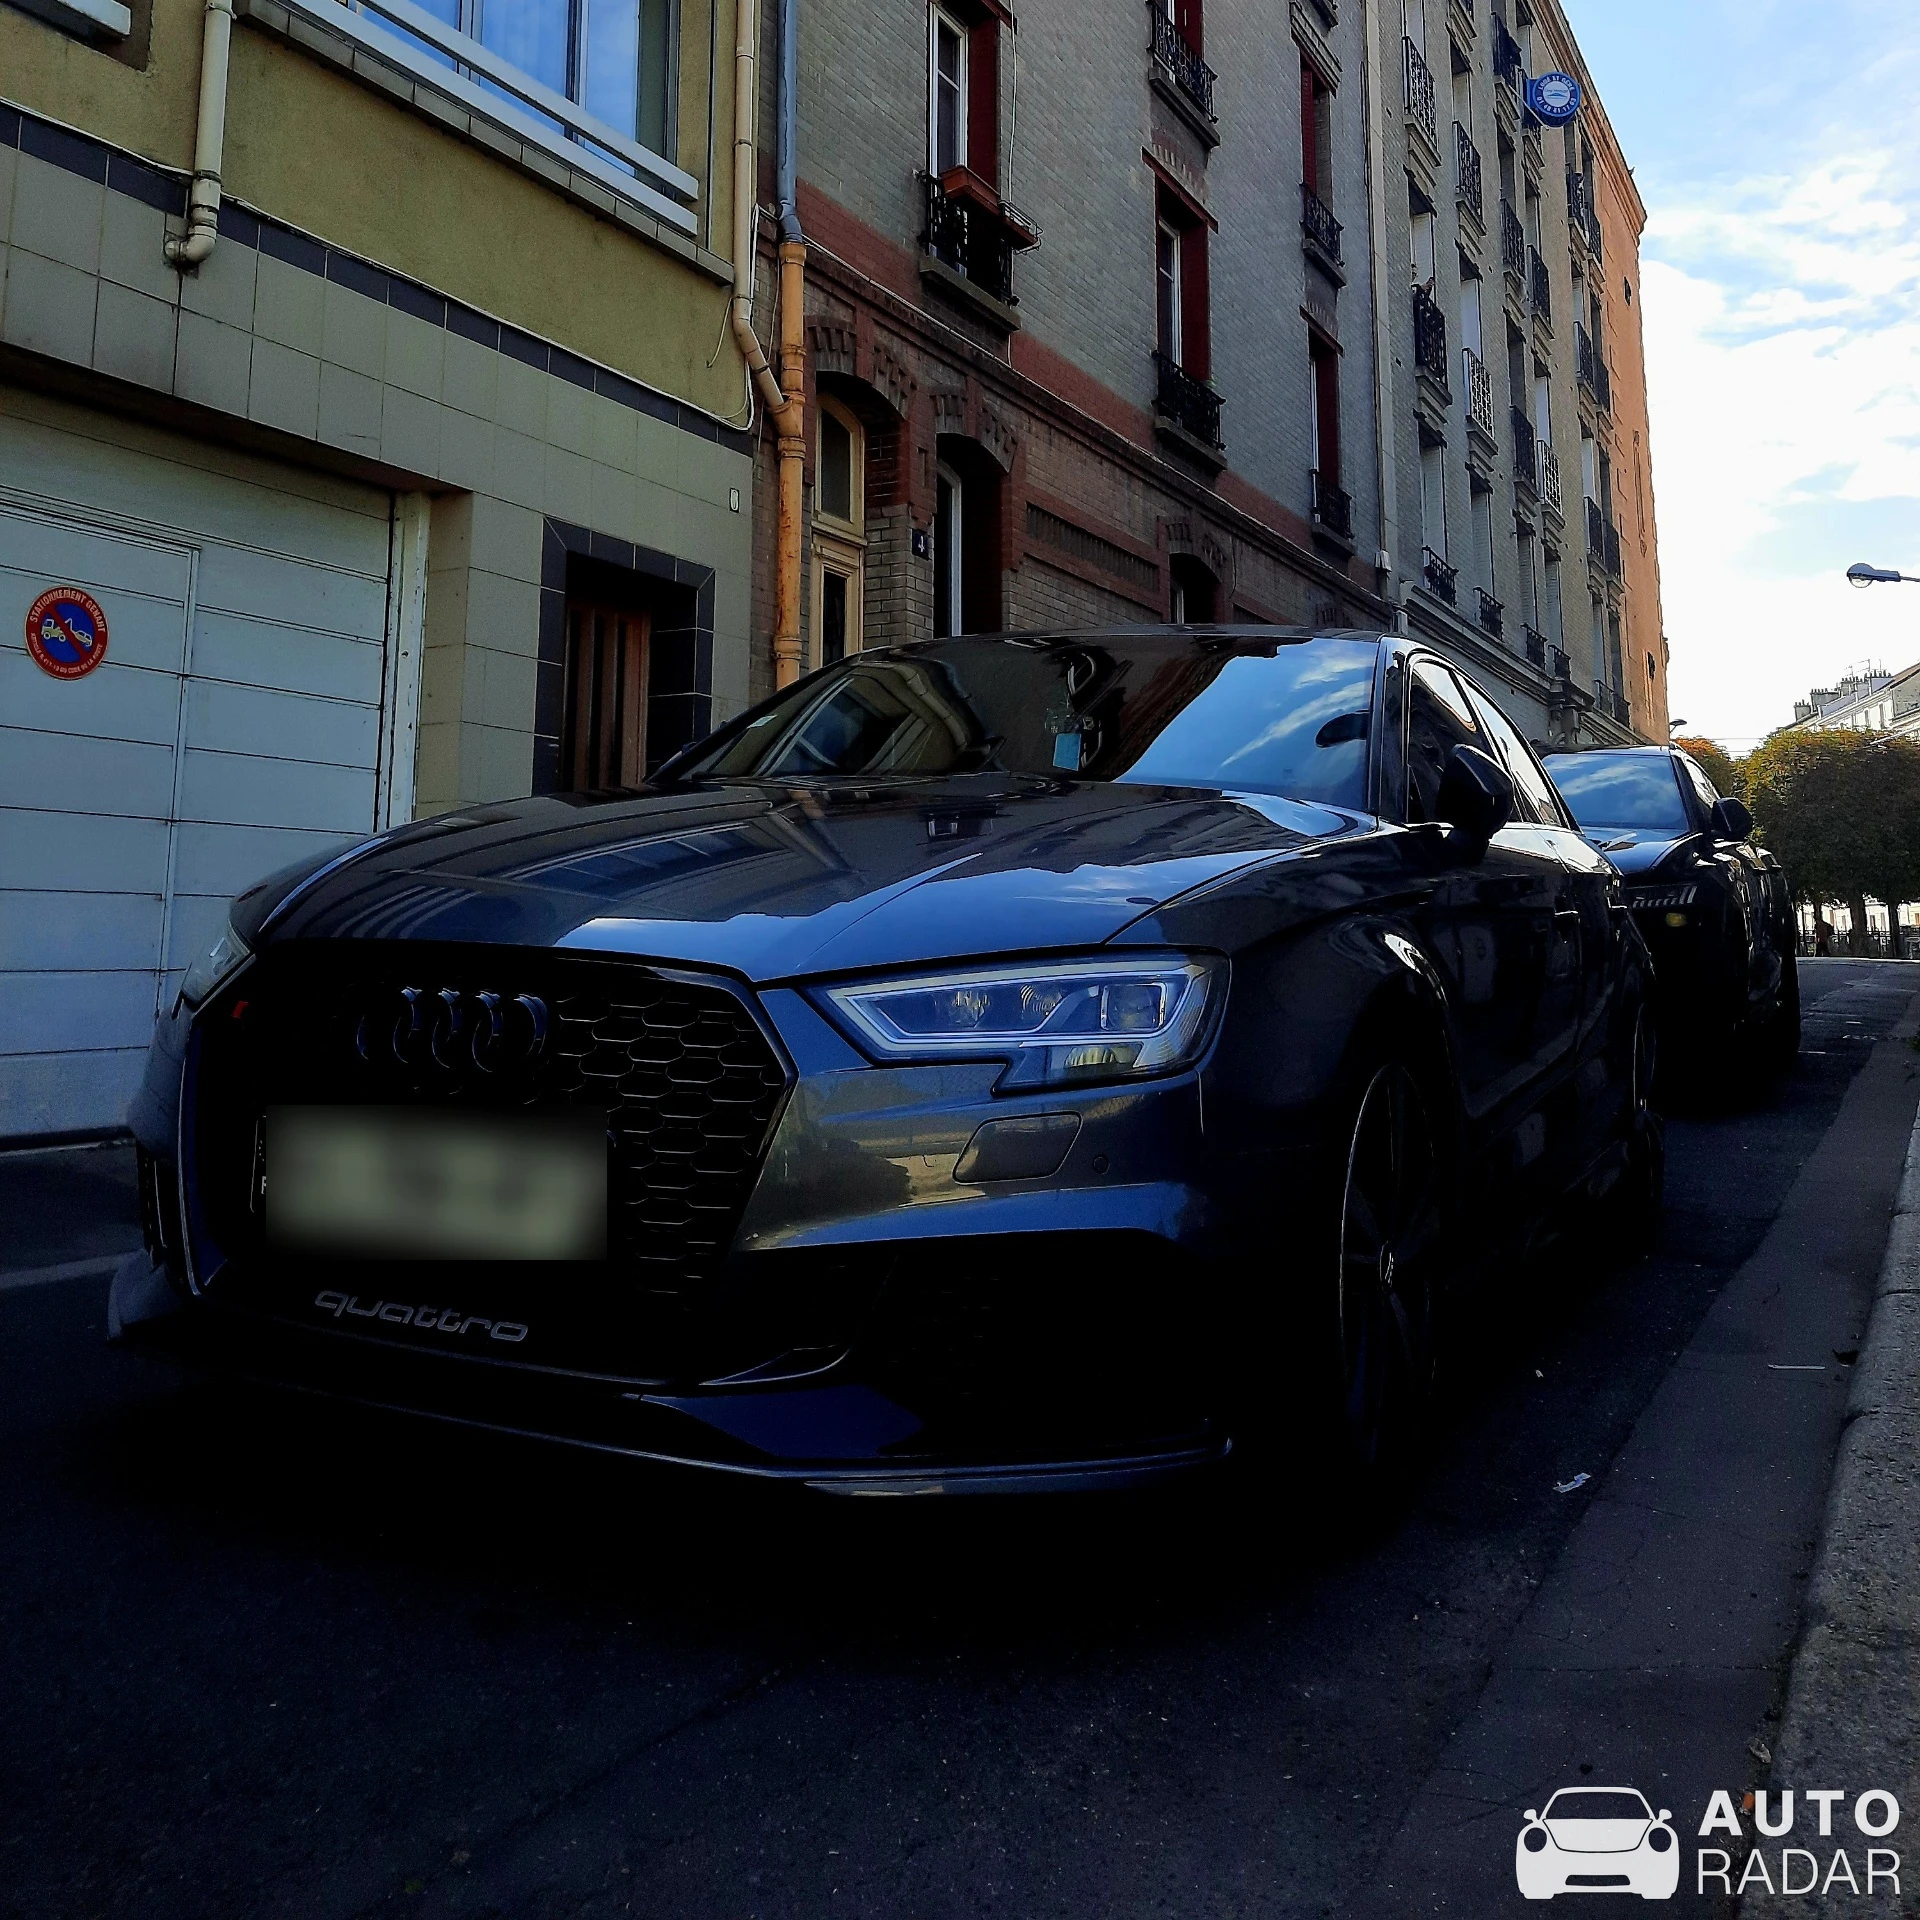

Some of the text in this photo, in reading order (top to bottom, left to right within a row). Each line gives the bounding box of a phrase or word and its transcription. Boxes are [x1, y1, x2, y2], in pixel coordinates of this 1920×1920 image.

[918, 535, 925, 553] 4
[30, 589, 87, 623] STATIONNEMENT
[314, 1288, 529, 1342] quattro
